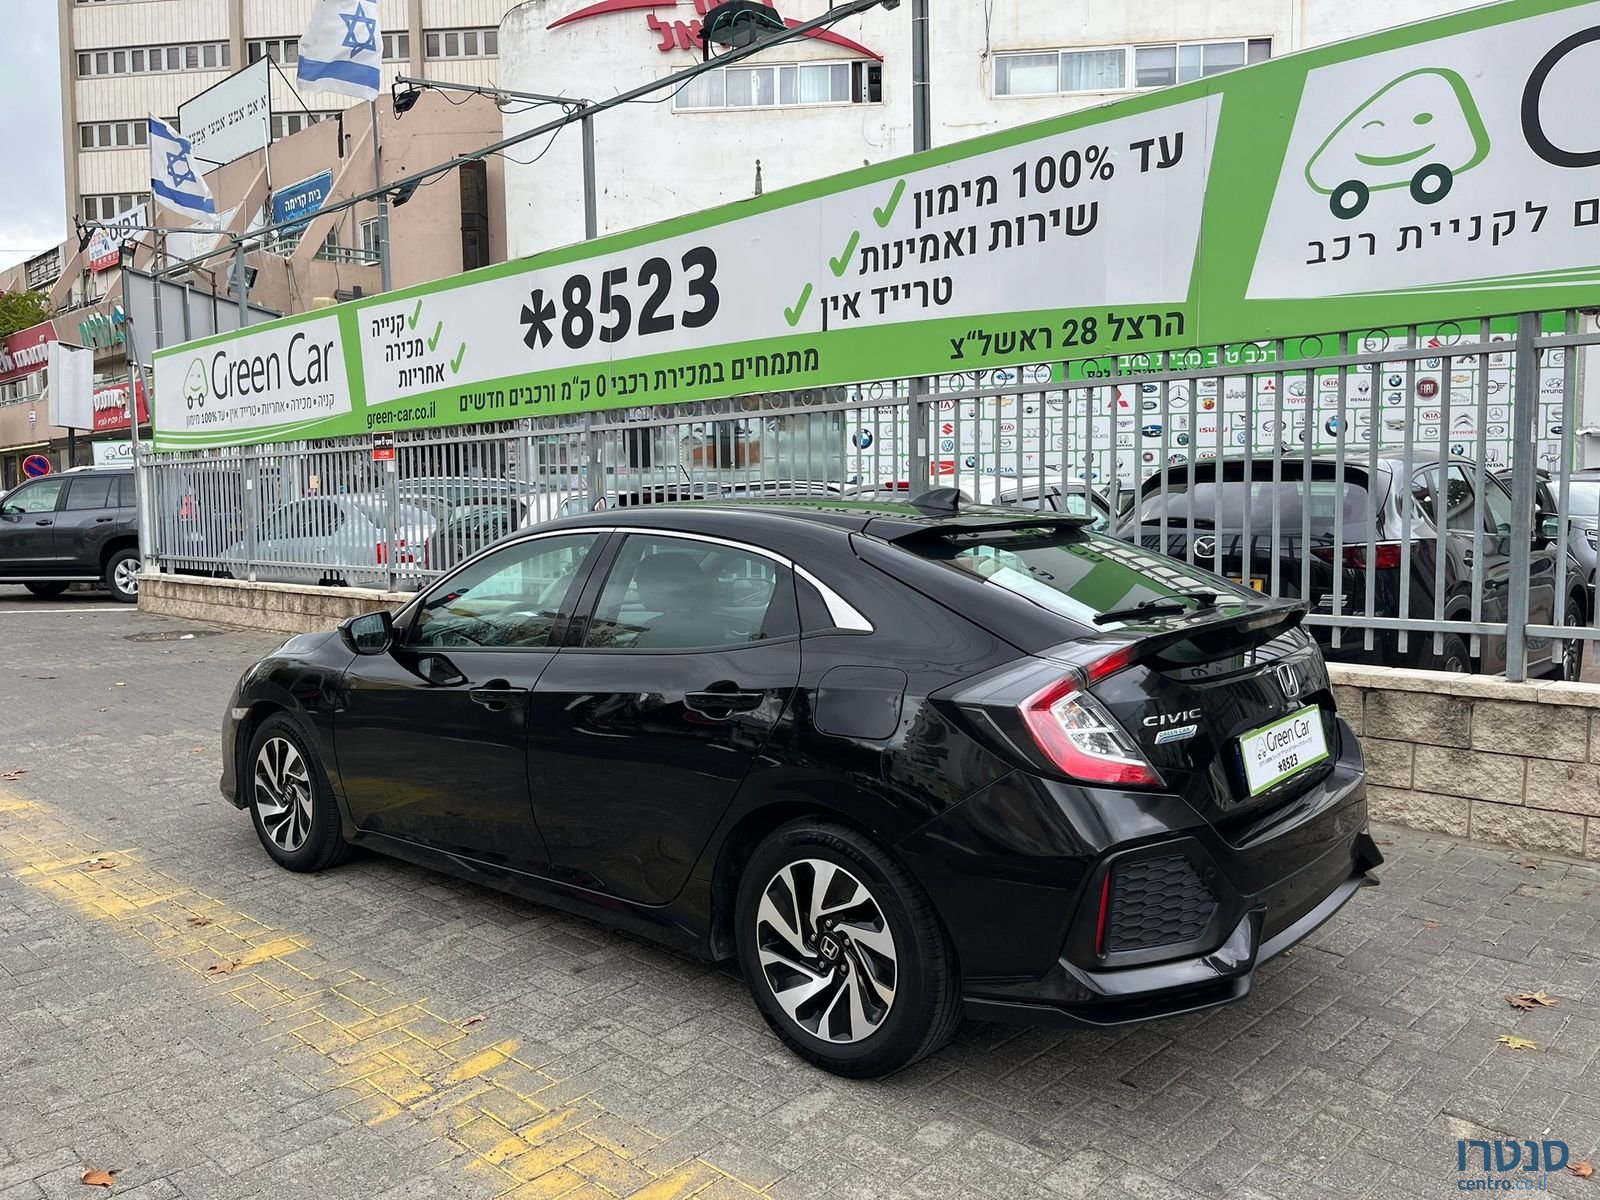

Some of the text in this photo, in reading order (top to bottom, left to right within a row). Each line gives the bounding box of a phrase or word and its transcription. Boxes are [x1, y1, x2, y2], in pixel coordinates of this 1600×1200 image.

[913, 131, 1184, 228] עד 100% מימון
[284, 188, 322, 212] בית קדימה
[1396, 200, 1548, 252] לקניית
[859, 201, 1099, 276] שירות ואמינות
[1306, 232, 1376, 265] רכב
[820, 275, 953, 333] טרייד אין
[371, 313, 405, 339] קנייה
[1061, 316, 1098, 348] 28
[1107, 311, 1185, 342] הרצל
[385, 338, 424, 363] מכירה
[1208, 352, 1238, 364] טב
[1245, 350, 1277, 363] רכב
[211, 332, 334, 400] Green Car
[398, 362, 445, 389] אחריות
[653, 361, 725, 391] במכירת
[731, 347, 819, 381] מתמחים
[509, 383, 556, 407] ורכבים
[596, 374, 607, 398] 0
[610, 372, 648, 396] רכבי
[1225, 389, 1246, 399] Jee
[1421, 383, 1434, 394] FIAT
[239, 405, 257, 417] טרייד
[261, 401, 286, 416] אחריות
[290, 397, 312, 411] מכירה
[317, 394, 335, 410] קניה
[459, 390, 505, 413] חדשים
[201, 412, 217, 424] 100%
[229, 407, 238, 423] אין
[366, 400, 438, 431] green-car.co.il
[1142, 707, 1202, 727] CIVIC
[1266, 719, 1310, 752] Green Car
